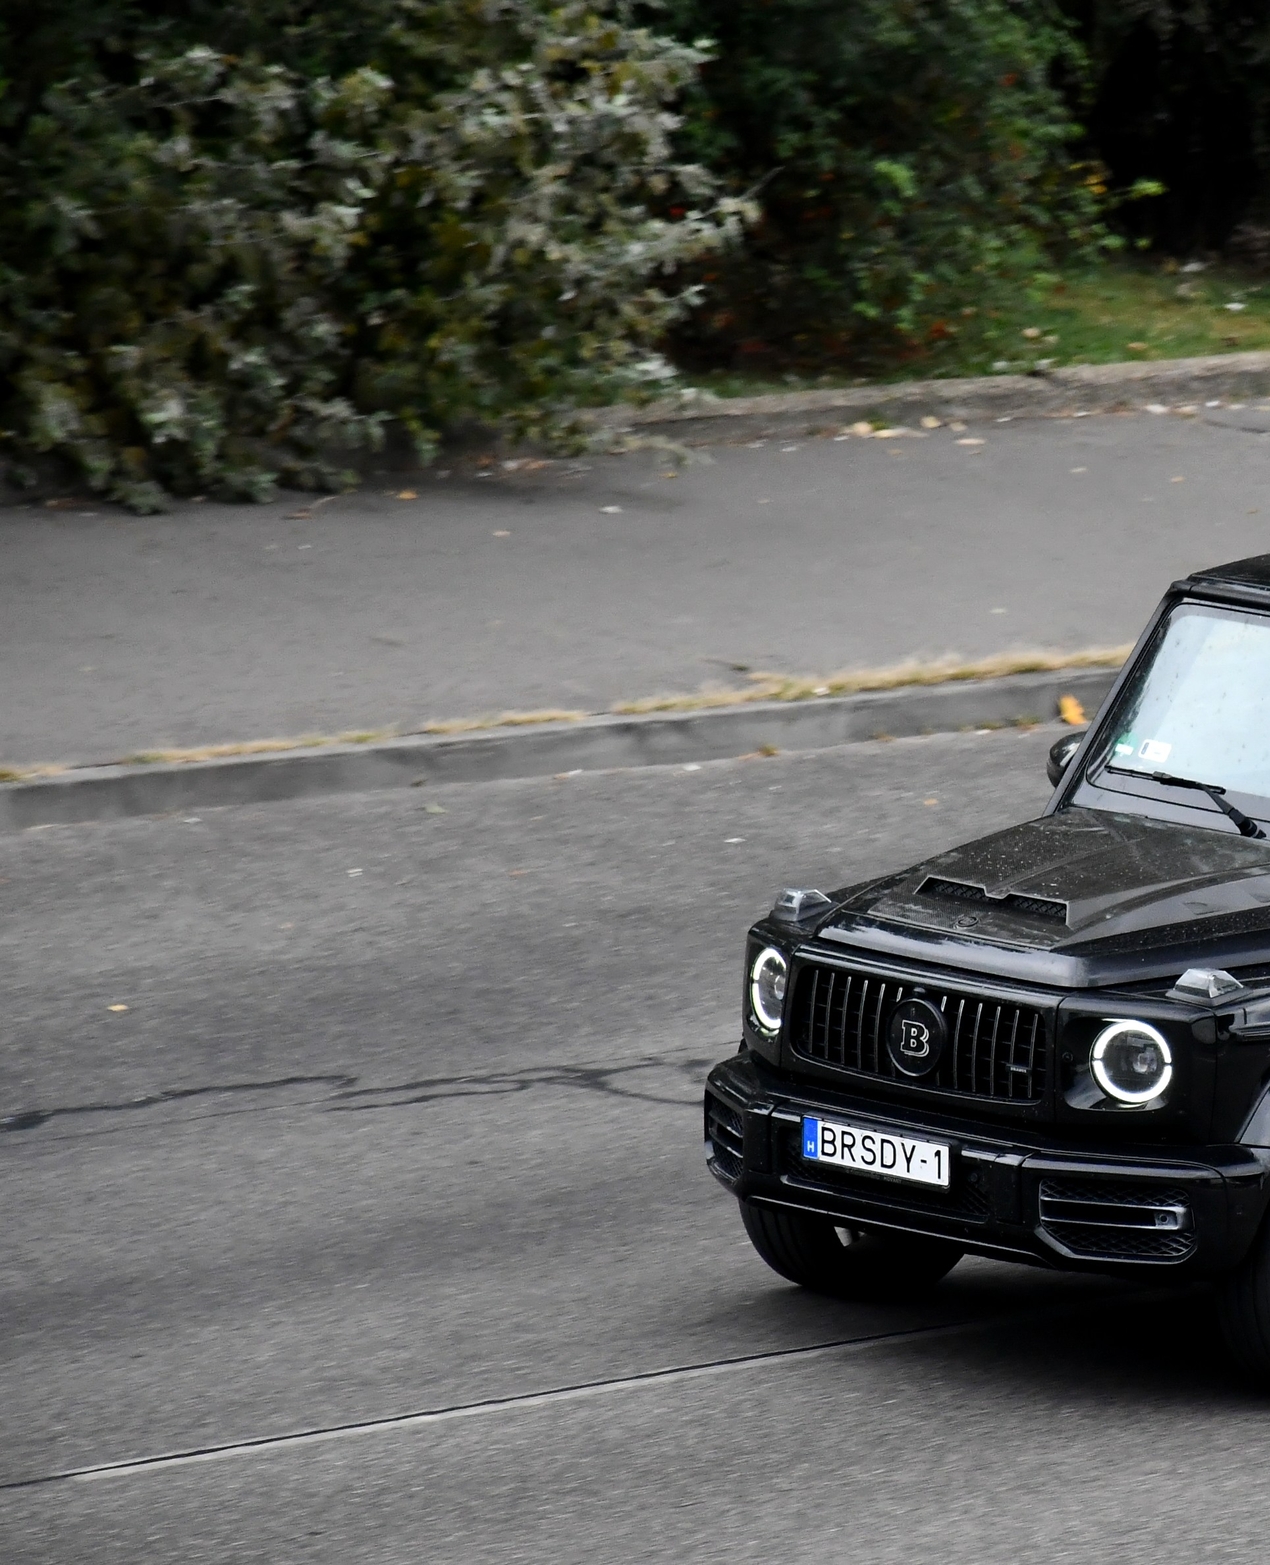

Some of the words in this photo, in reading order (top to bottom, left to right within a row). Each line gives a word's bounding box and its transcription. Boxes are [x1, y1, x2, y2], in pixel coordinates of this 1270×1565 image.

[900, 1020, 930, 1057] B
[807, 1141, 815, 1153] H
[821, 1126, 942, 1179] BRSDY-1
